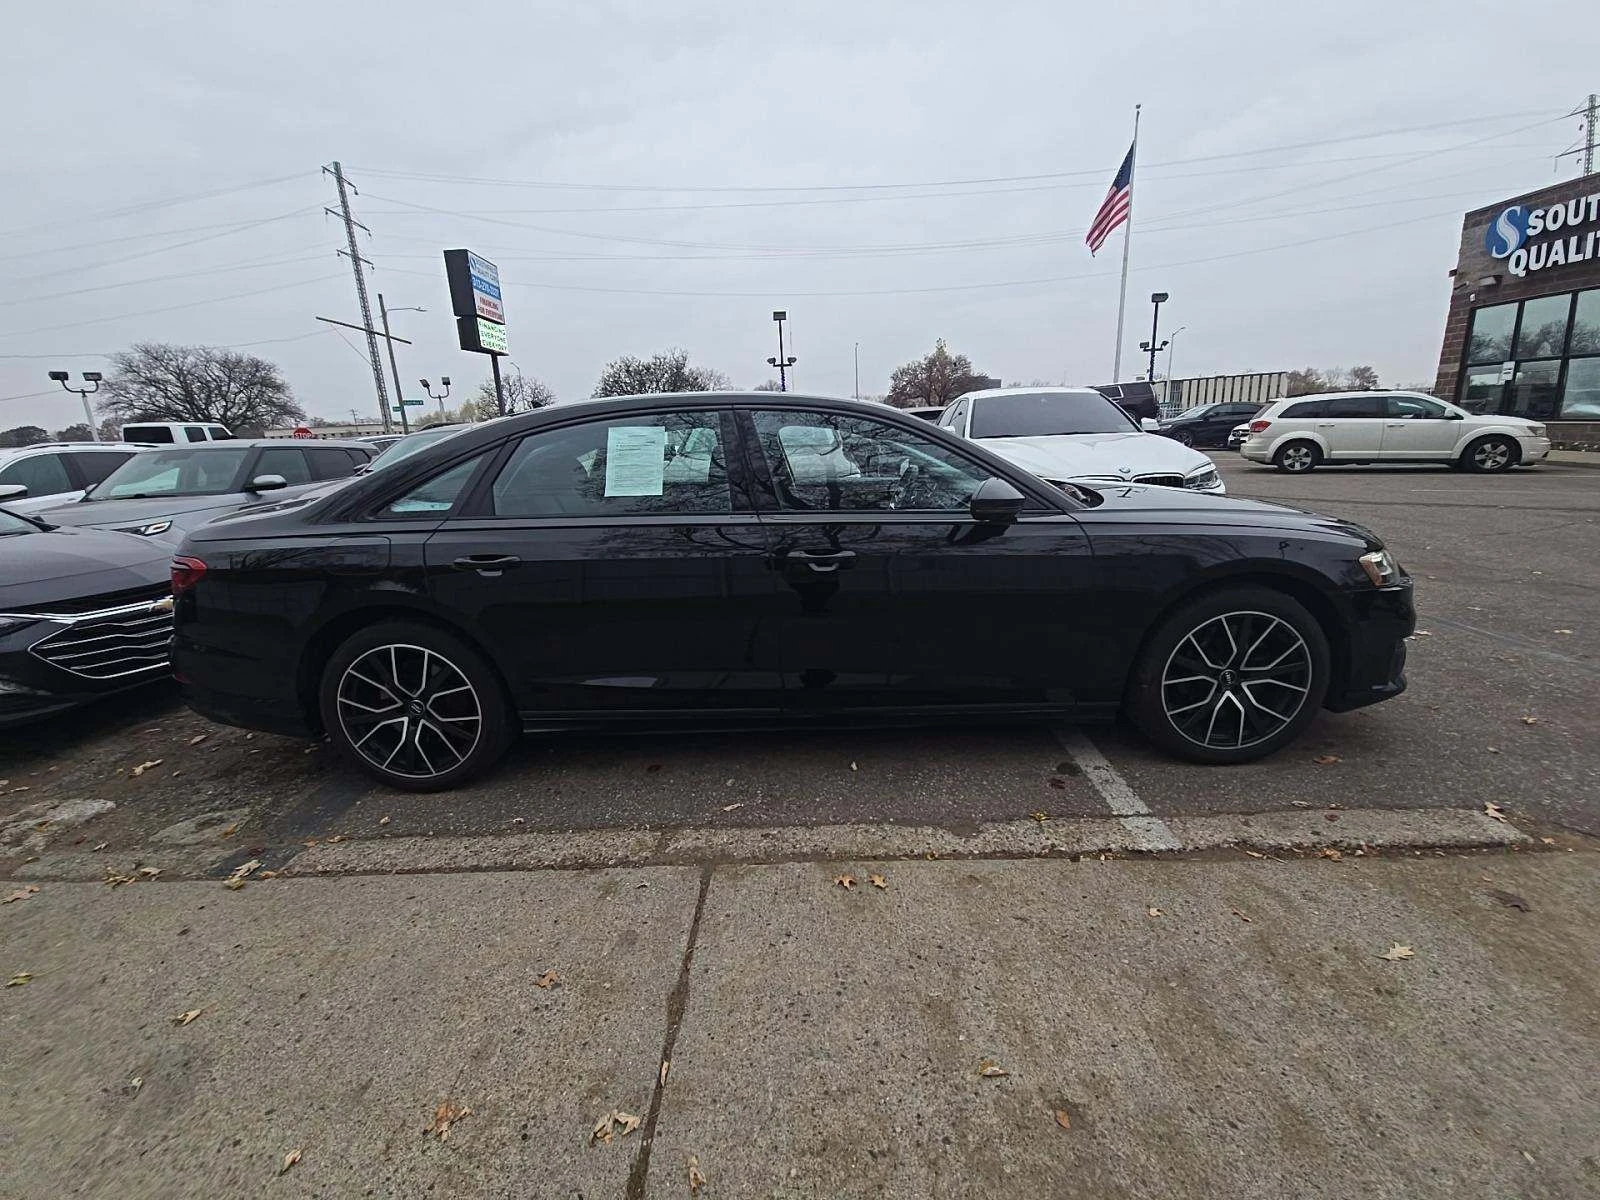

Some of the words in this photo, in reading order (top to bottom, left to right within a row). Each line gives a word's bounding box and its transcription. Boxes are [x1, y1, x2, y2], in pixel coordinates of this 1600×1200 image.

[1526, 193, 1600, 236] SOUT
[1508, 230, 1600, 277] QUALI
[479, 320, 505, 335] FINANCING
[481, 330, 506, 344] EVERYONE
[482, 339, 507, 351] EVERYDAY
